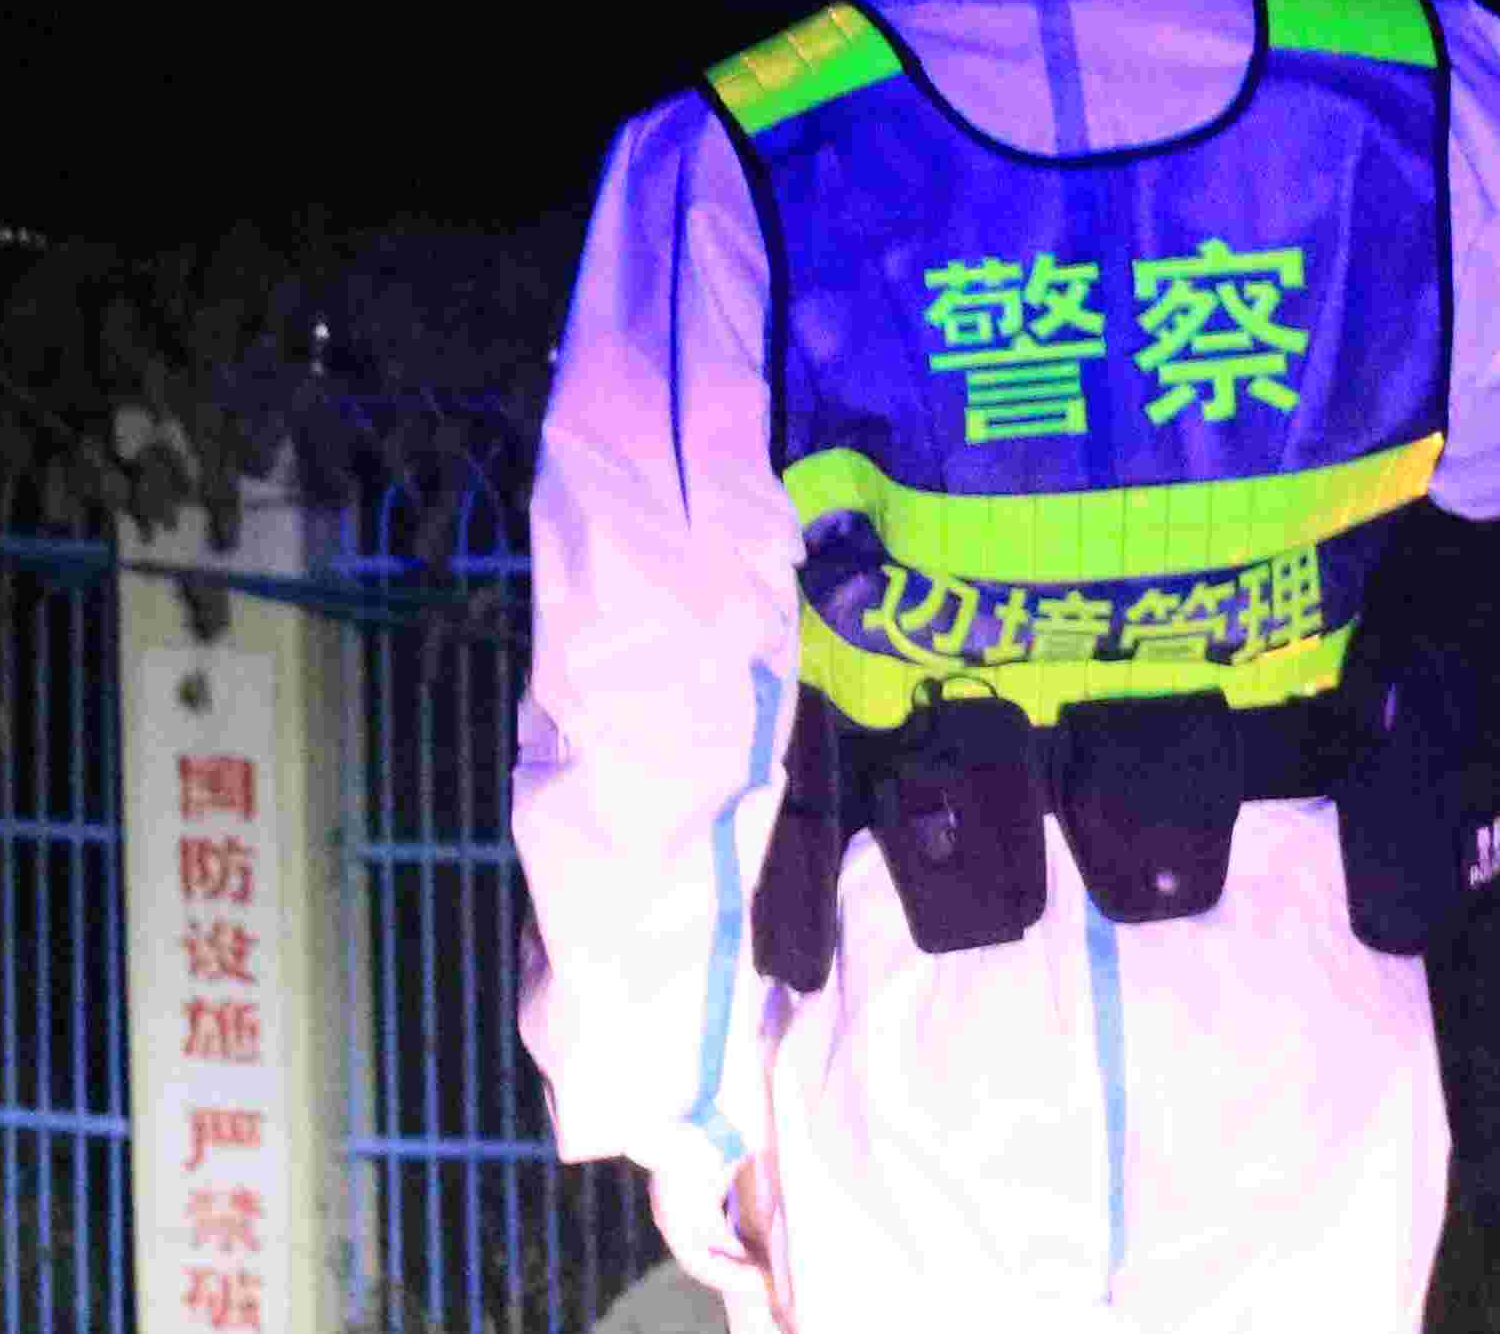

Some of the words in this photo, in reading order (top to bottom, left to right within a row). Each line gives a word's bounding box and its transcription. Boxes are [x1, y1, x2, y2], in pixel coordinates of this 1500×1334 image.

[924, 239, 1308, 444] 警察
[176, 754, 260, 1063] 国防设施
